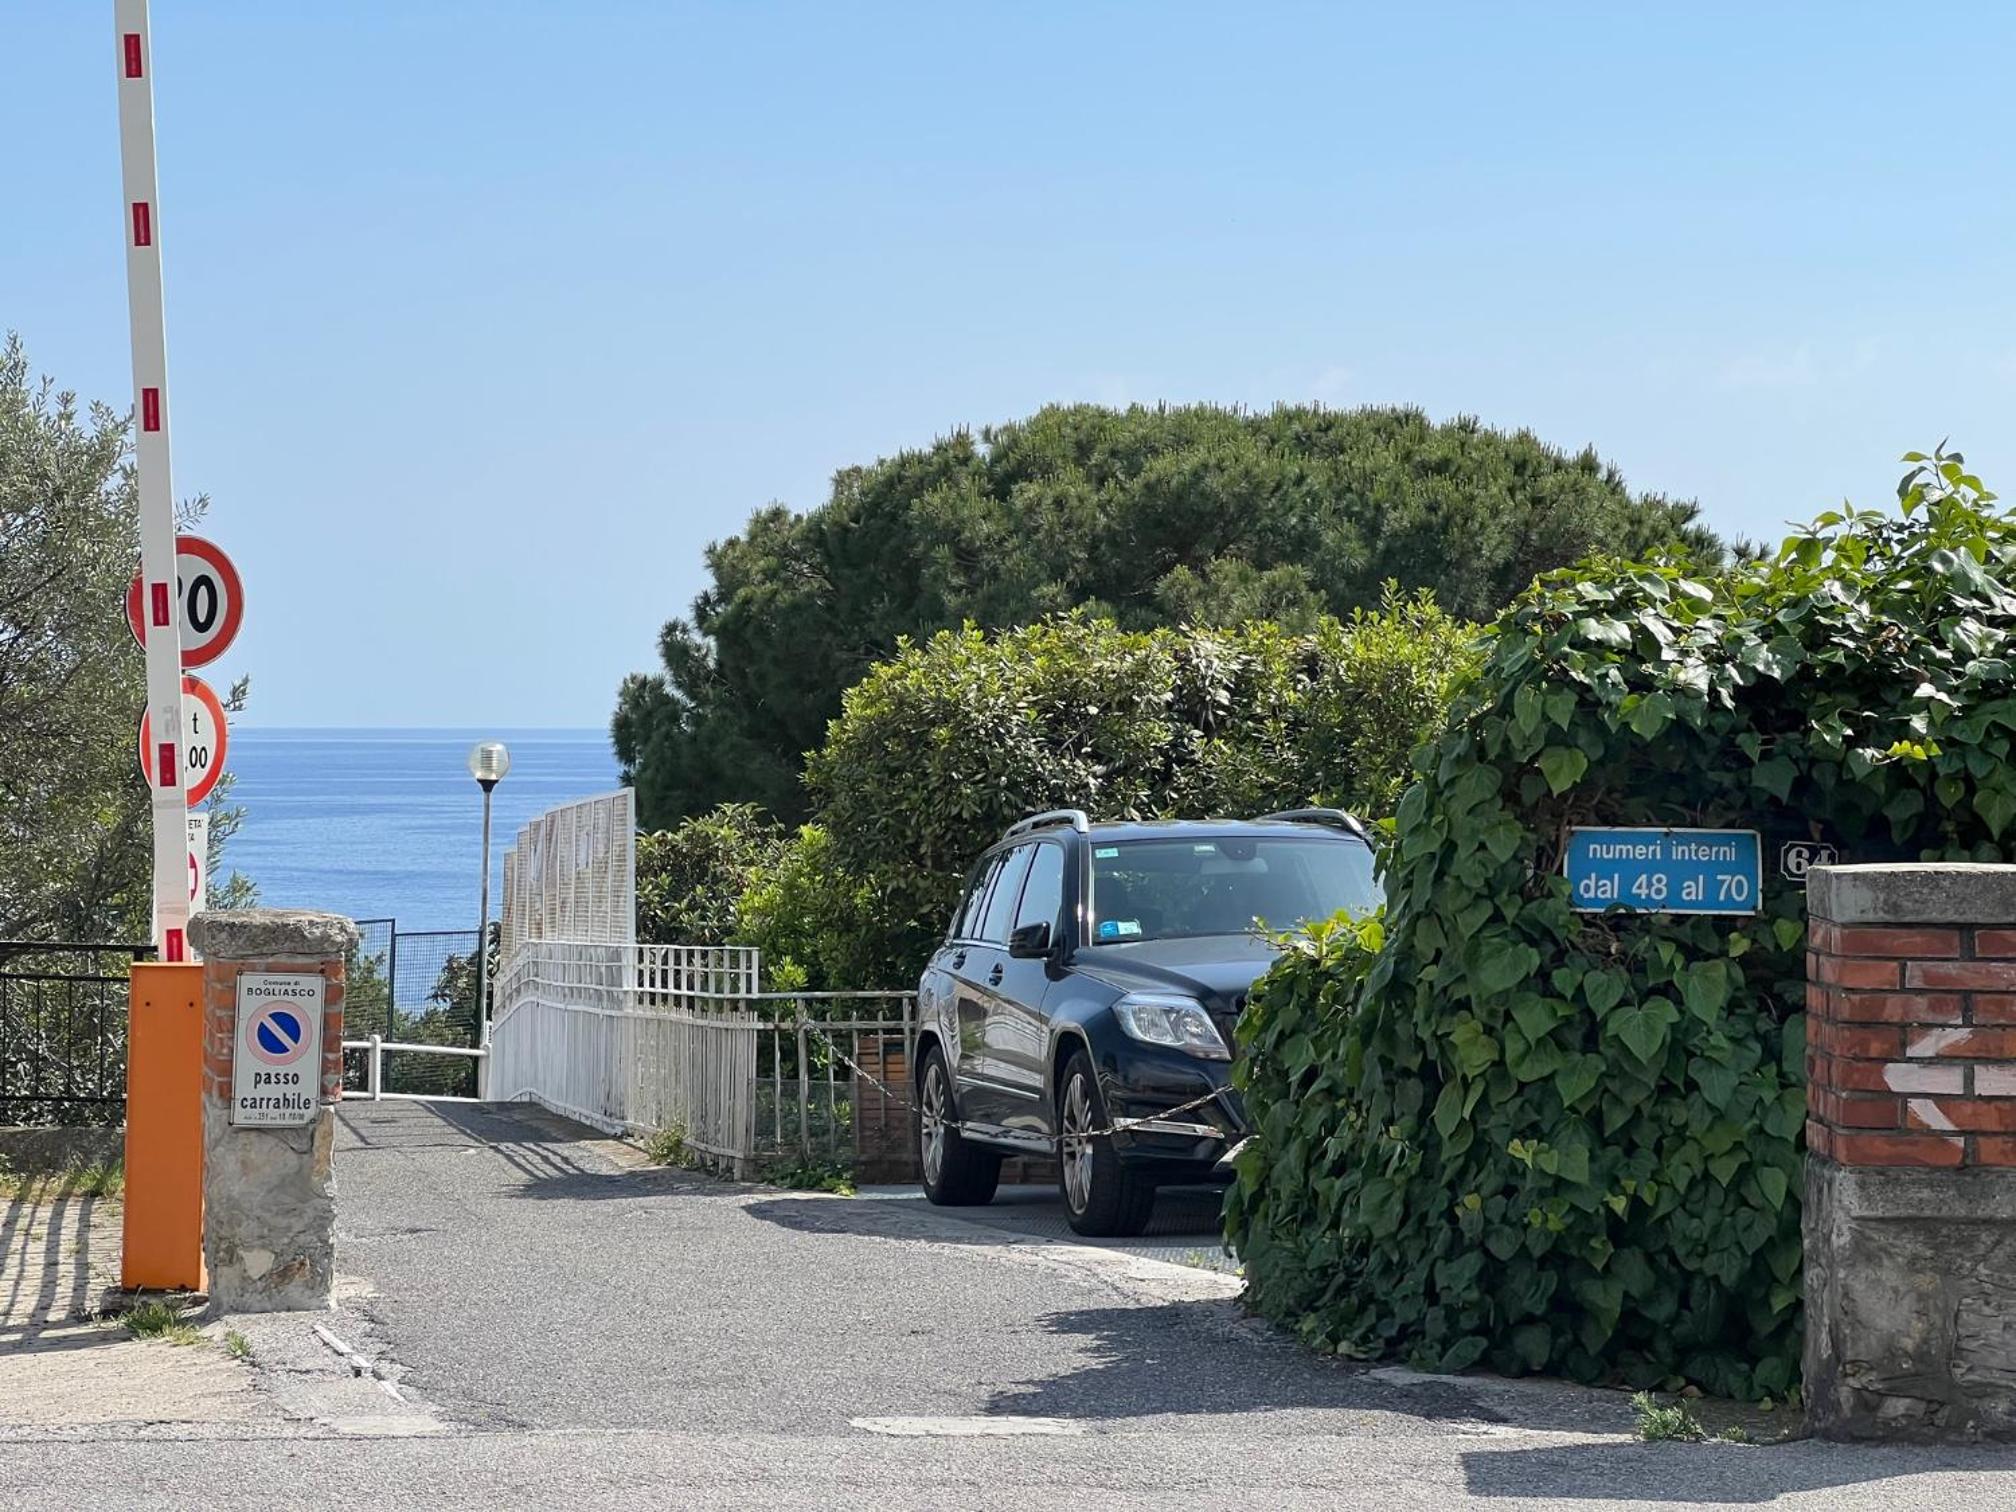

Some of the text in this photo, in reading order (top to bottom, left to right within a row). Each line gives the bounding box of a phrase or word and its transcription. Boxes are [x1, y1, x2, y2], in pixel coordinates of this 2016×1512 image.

[177, 574, 218, 633] 0
[192, 712, 199, 734] t
[1589, 840, 1736, 861] numeri interni
[1787, 847, 1831, 874] 64
[1579, 873, 1749, 901] dal 48 al 70
[246, 987, 316, 997] BOGLIASCO
[254, 1072, 300, 1089] passo
[240, 1092, 312, 1110] carrabile
